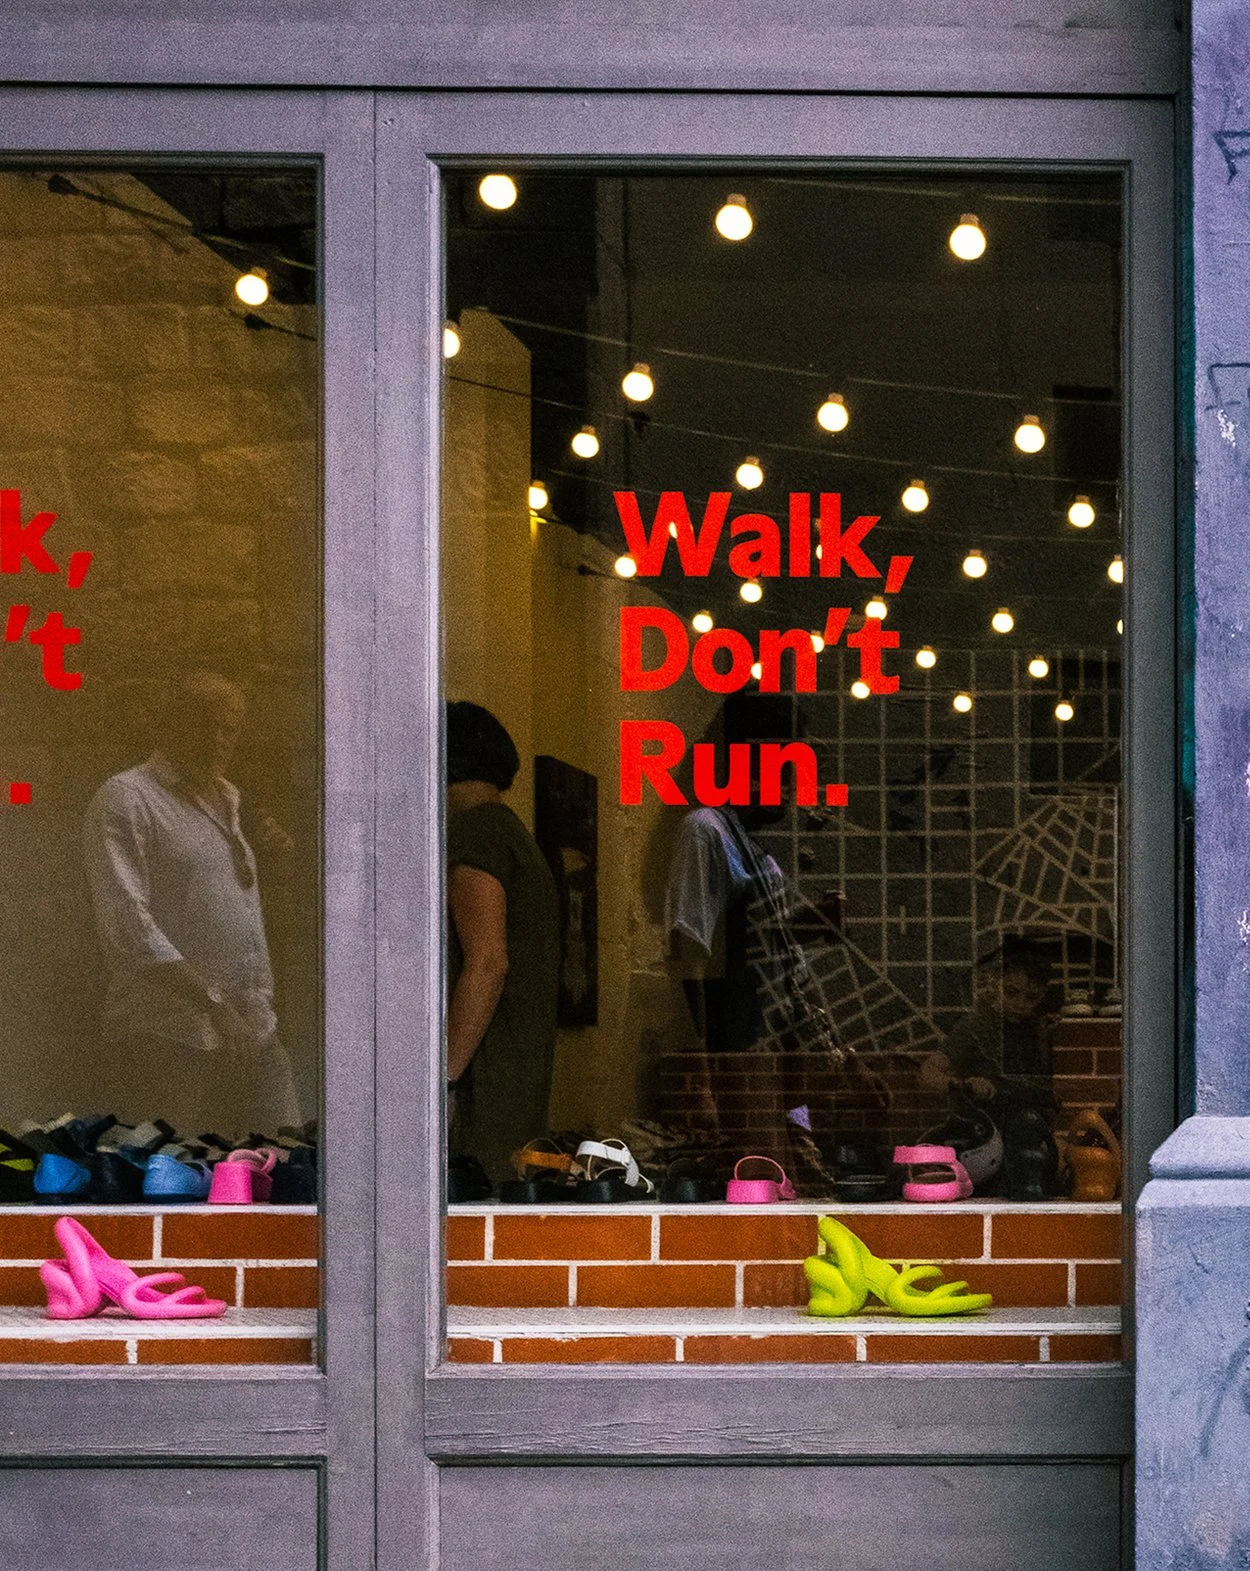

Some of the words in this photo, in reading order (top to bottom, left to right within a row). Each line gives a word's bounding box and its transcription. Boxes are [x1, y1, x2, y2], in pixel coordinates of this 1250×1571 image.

[613, 490, 914, 594] Walk,
[619, 606, 901, 695] Don't
[619, 719, 849, 807] Run.
